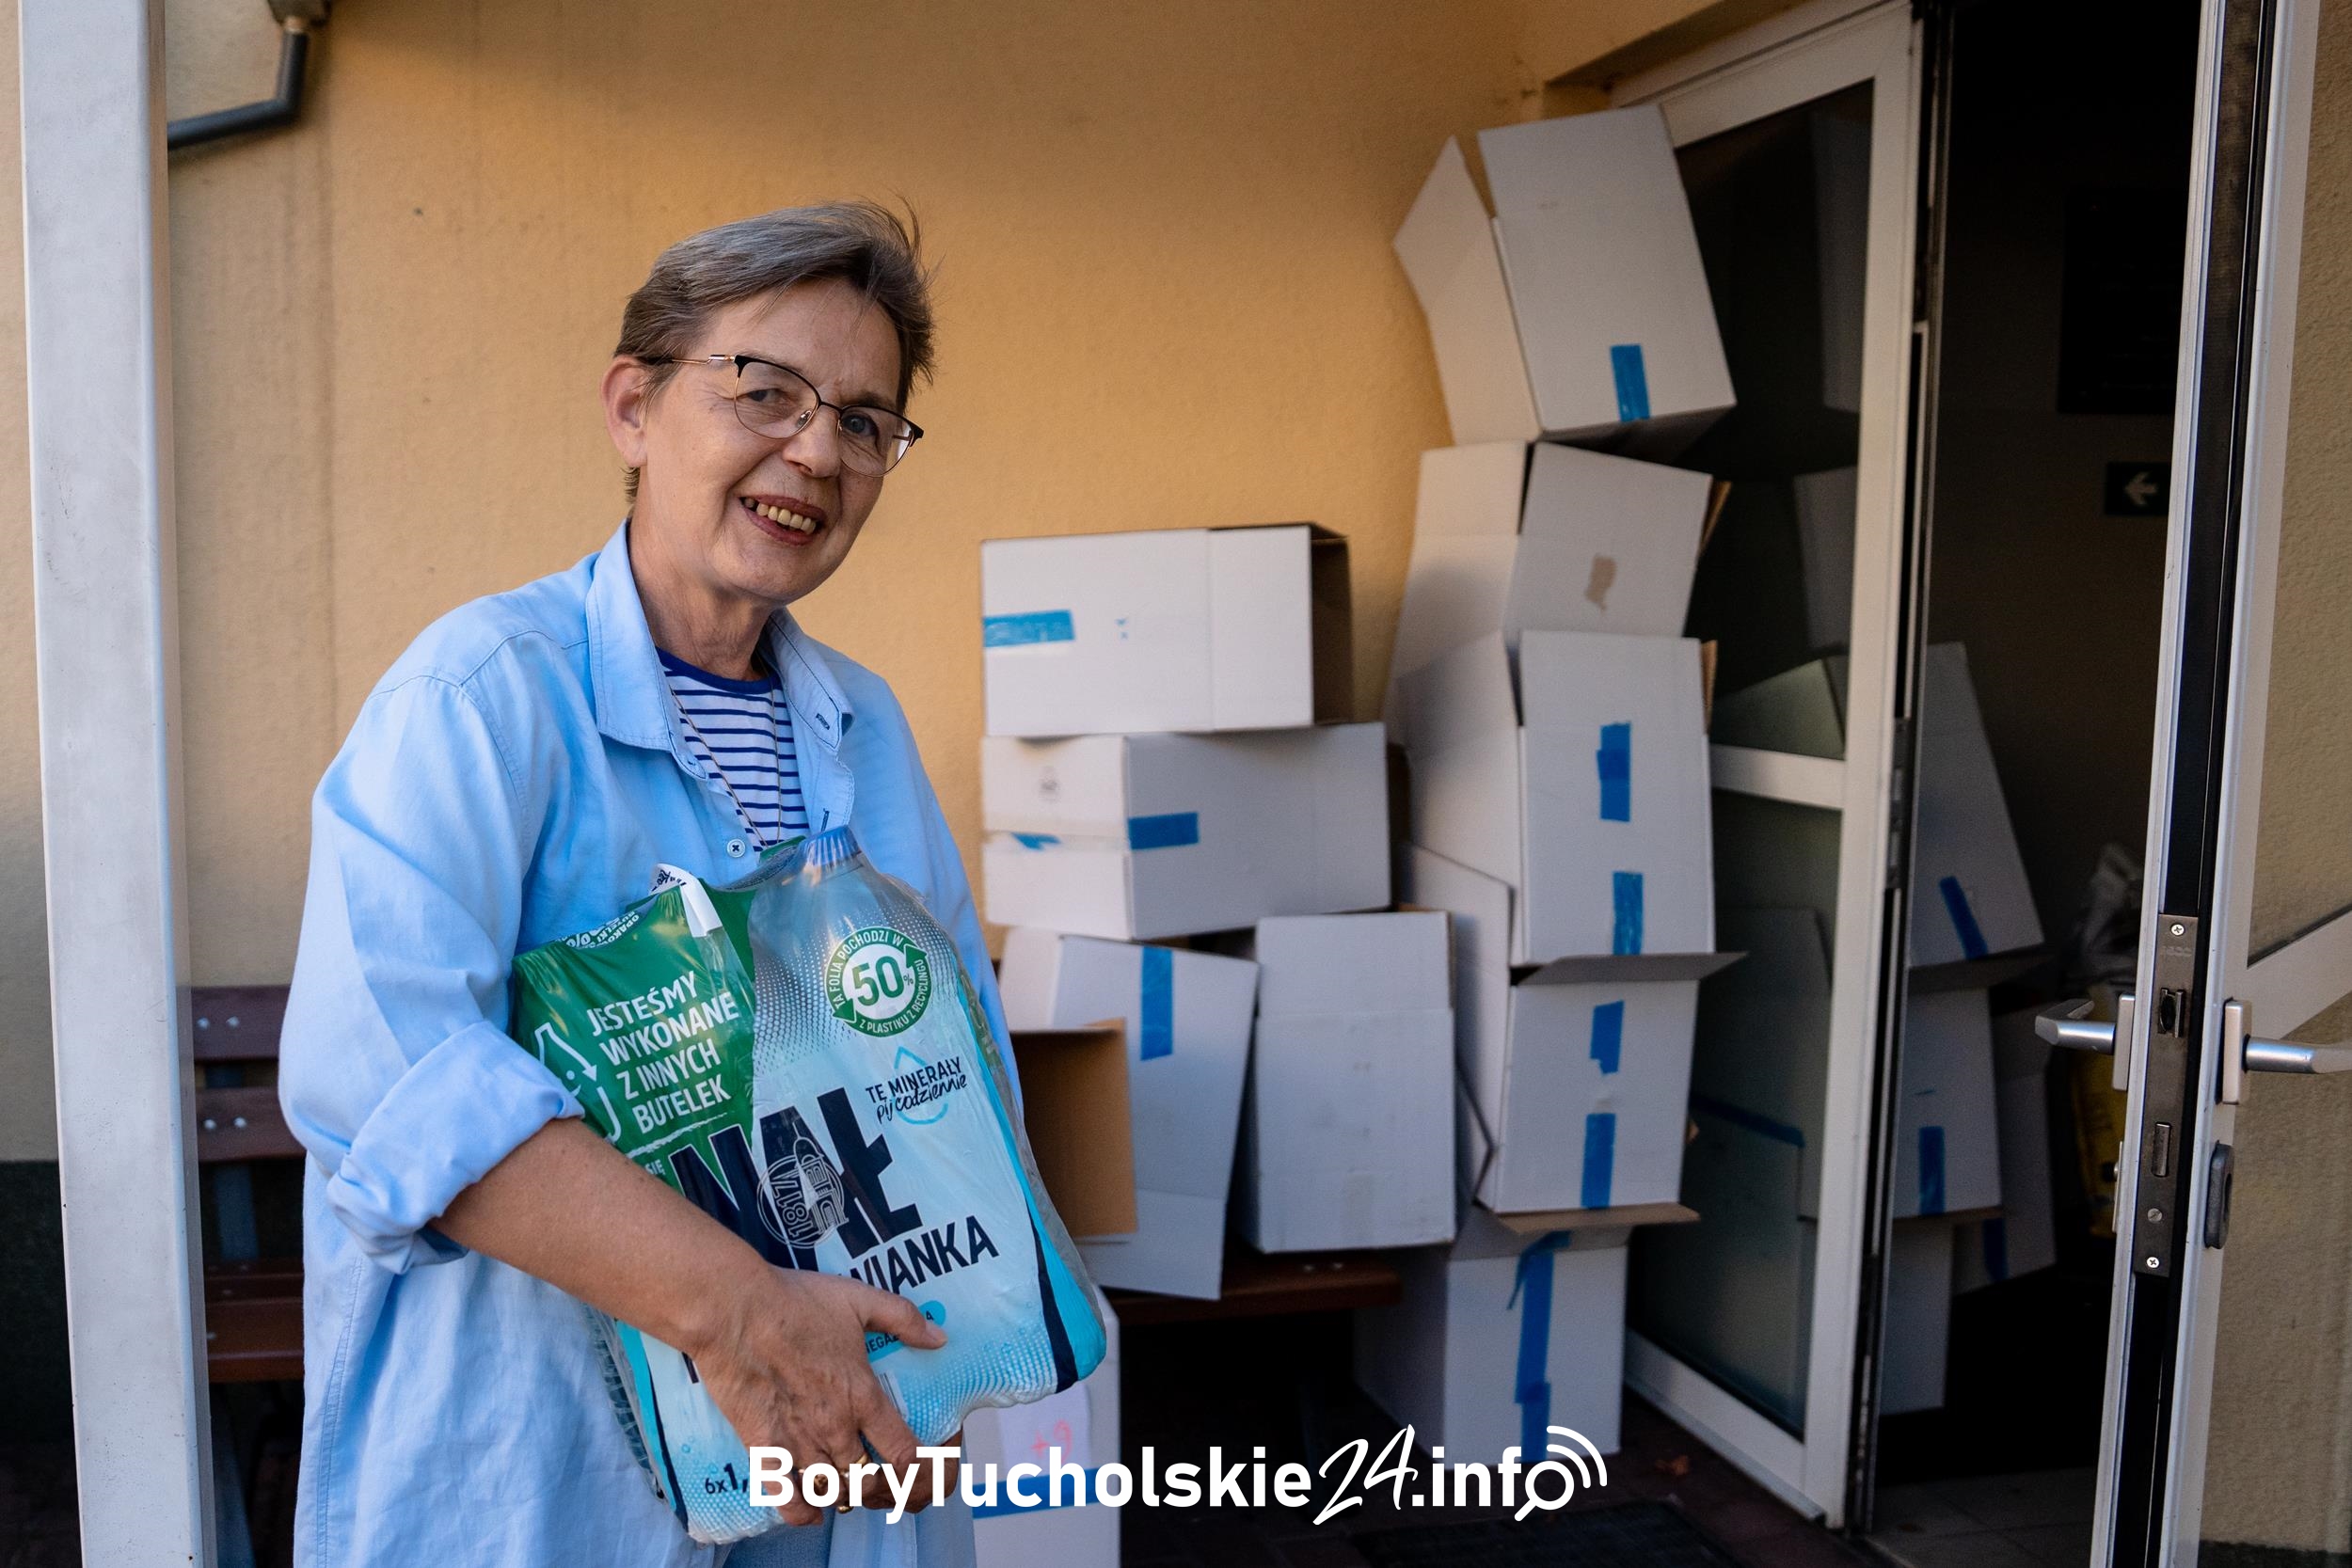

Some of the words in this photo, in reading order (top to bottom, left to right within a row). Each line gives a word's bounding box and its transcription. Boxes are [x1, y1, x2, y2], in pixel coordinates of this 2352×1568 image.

[836, 930, 889, 959] POCHODZI
[892, 933, 904, 947] W
[829, 960, 844, 993] FOLIA
[833, 993, 846, 1009] TA
[859, 1019, 866, 1029] Z
[866, 1016, 910, 1034] PLASTIKU
[907, 1009, 916, 1020] Z
[912, 958, 929, 1013] RECYCLINGU
[586, 971, 698, 1037] JESTEŚMY
[599, 991, 739, 1066] WYKONANE
[616, 1070, 639, 1101] Z
[636, 1038, 722, 1091] INNYCH
[866, 1084, 887, 1103] TE
[887, 1056, 961, 1097] MINERAŁY
[631, 1074, 732, 1133] BUTELEK
[876, 1099, 893, 1125] pij
[895, 1074, 967, 1112] codziennie
